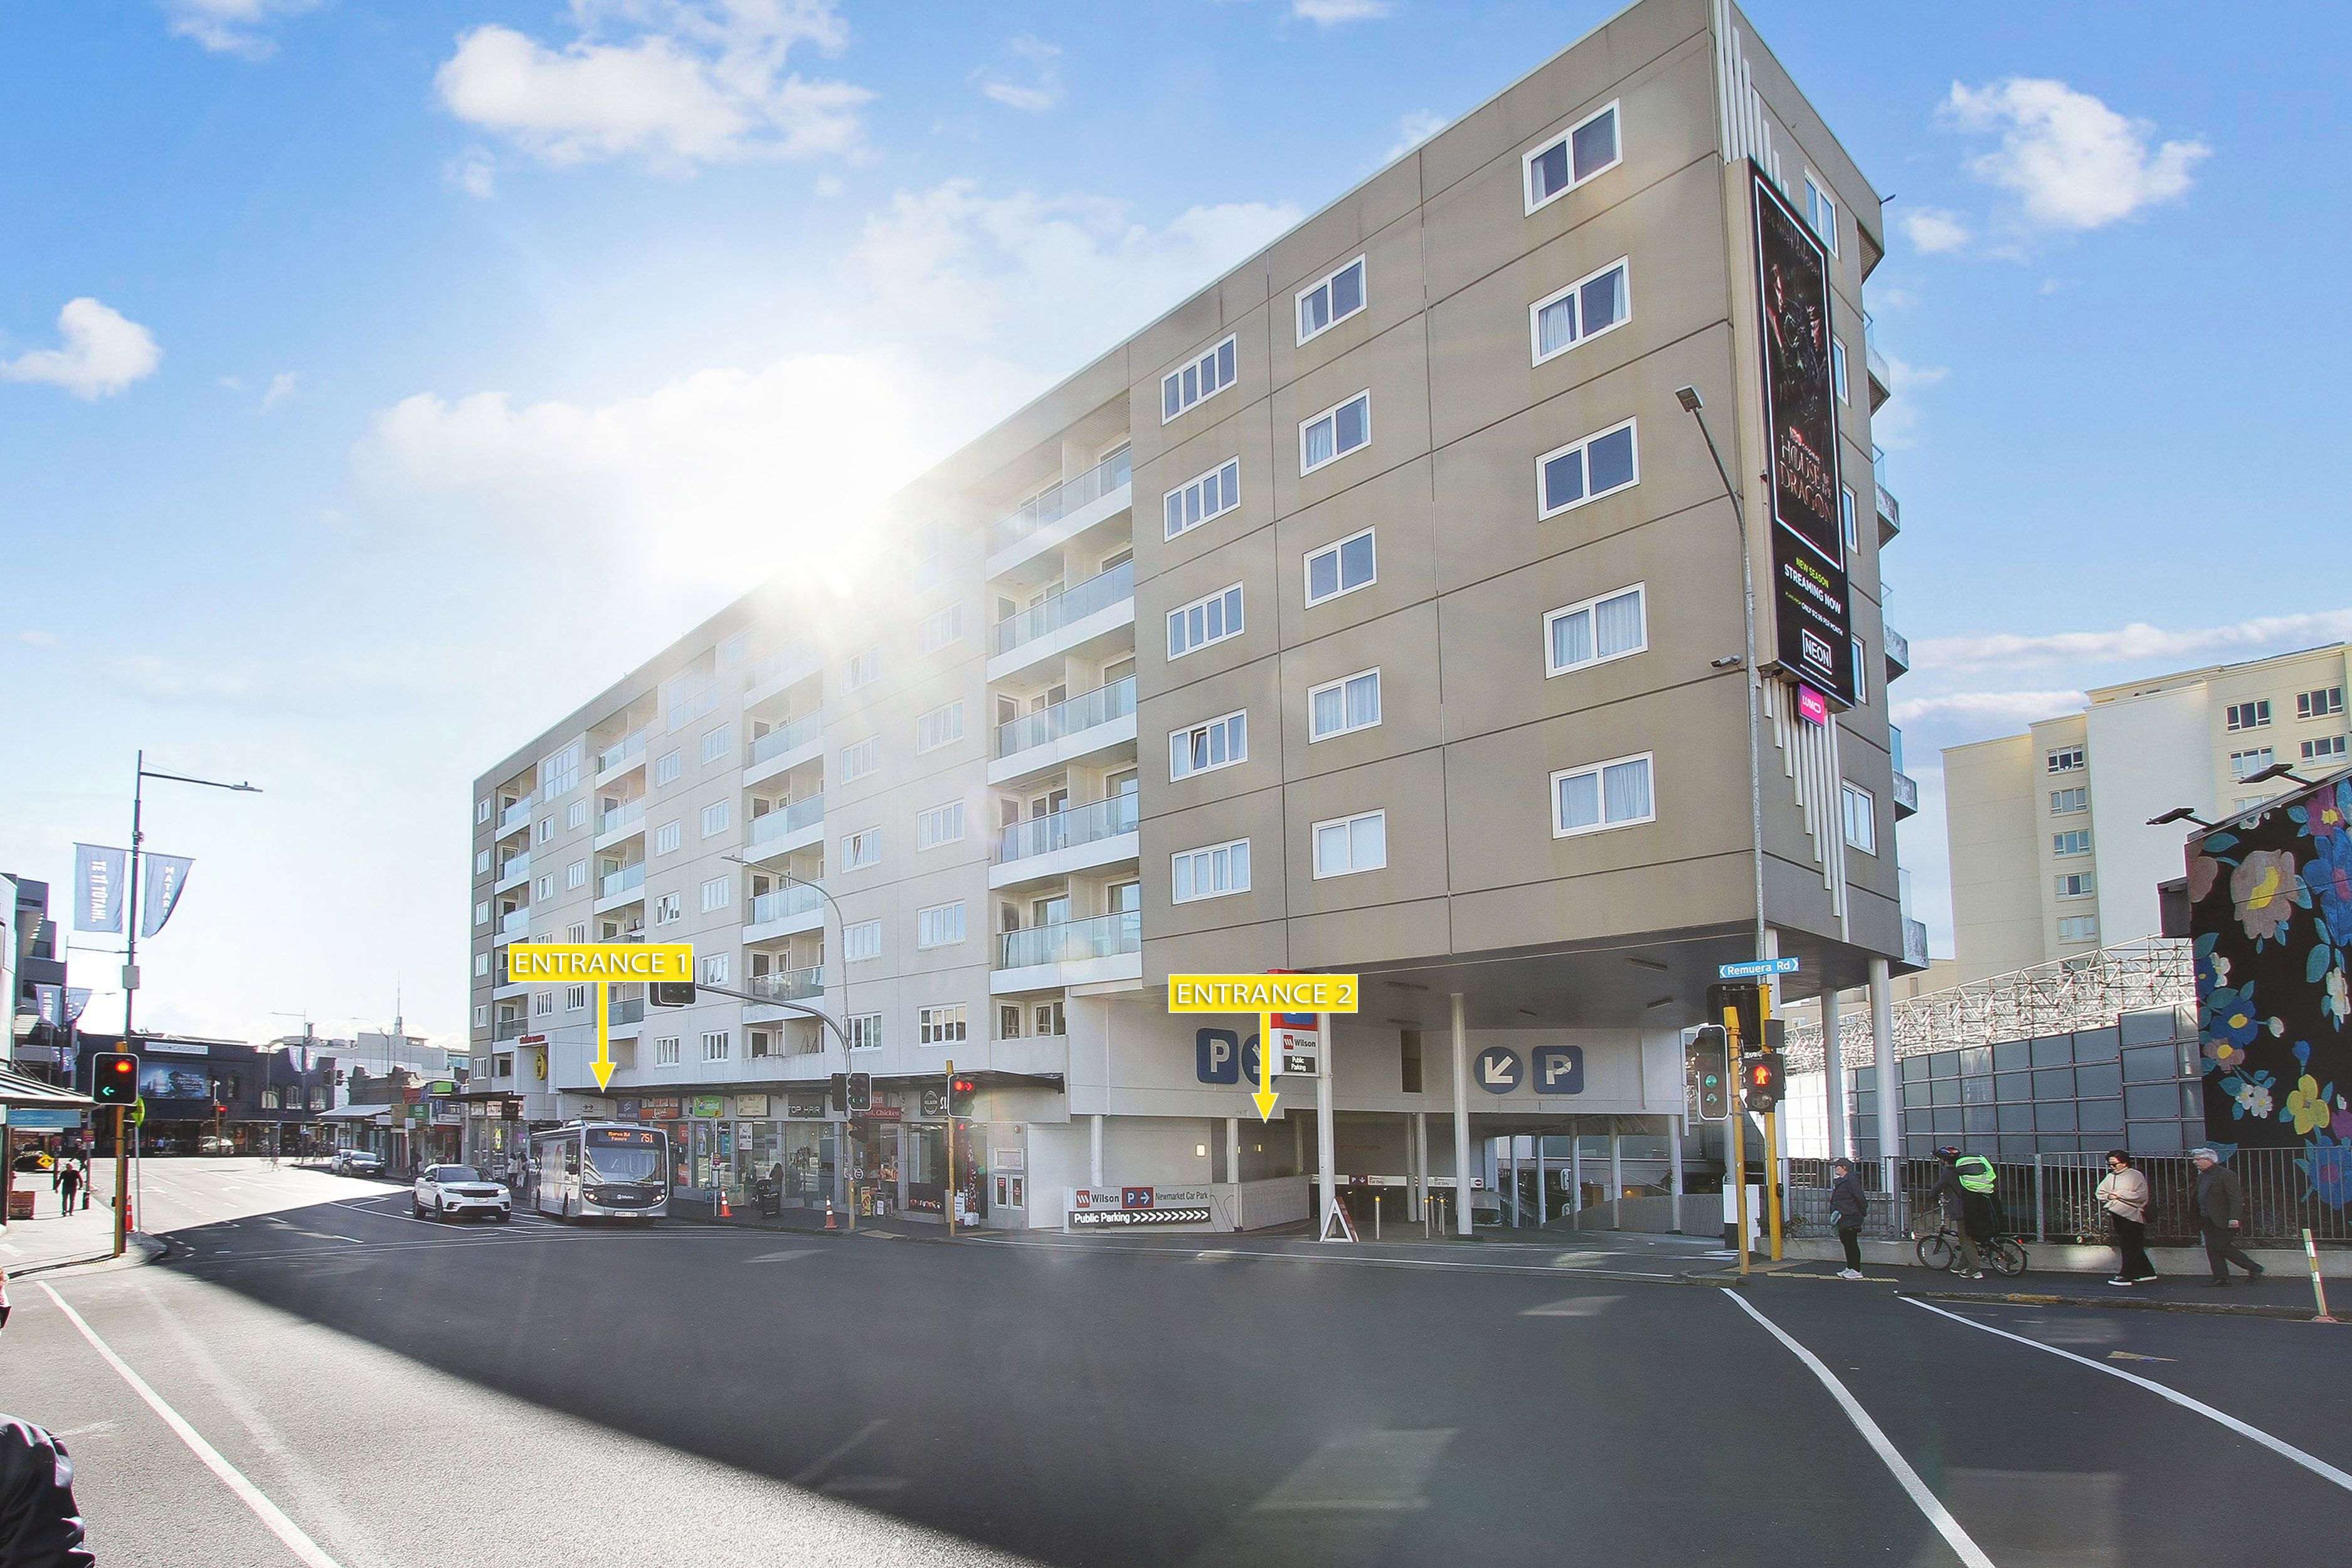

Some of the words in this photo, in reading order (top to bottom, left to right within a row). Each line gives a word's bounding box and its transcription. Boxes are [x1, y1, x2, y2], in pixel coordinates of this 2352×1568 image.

[1781, 435, 1820, 489] HOUSE
[1780, 460, 1834, 527] DRAGON
[1796, 557, 1808, 573] NEW
[1809, 567, 1829, 588] SEASON
[1784, 563, 1824, 602] STREAMING
[1825, 593, 1841, 614] NOW
[1805, 637, 1830, 667] NEON
[1727, 964, 1772, 976] Remuera
[1776, 960, 1790, 971] Rd
[1210, 1039, 1230, 1073] P
[1294, 1039, 1316, 1047] Wilson
[1545, 1054, 1572, 1085] P
[640, 1133, 653, 1143] 751
[1091, 1194, 1120, 1203] Wilson
[1127, 1192, 1135, 1203] P
[1155, 1192, 1185, 1200] Newmarket
[1185, 1192, 1195, 1200] Car
[1196, 1191, 1208, 1199] Park
[1074, 1212, 1099, 1223] Public
[1100, 1211, 1130, 1224] Parking
